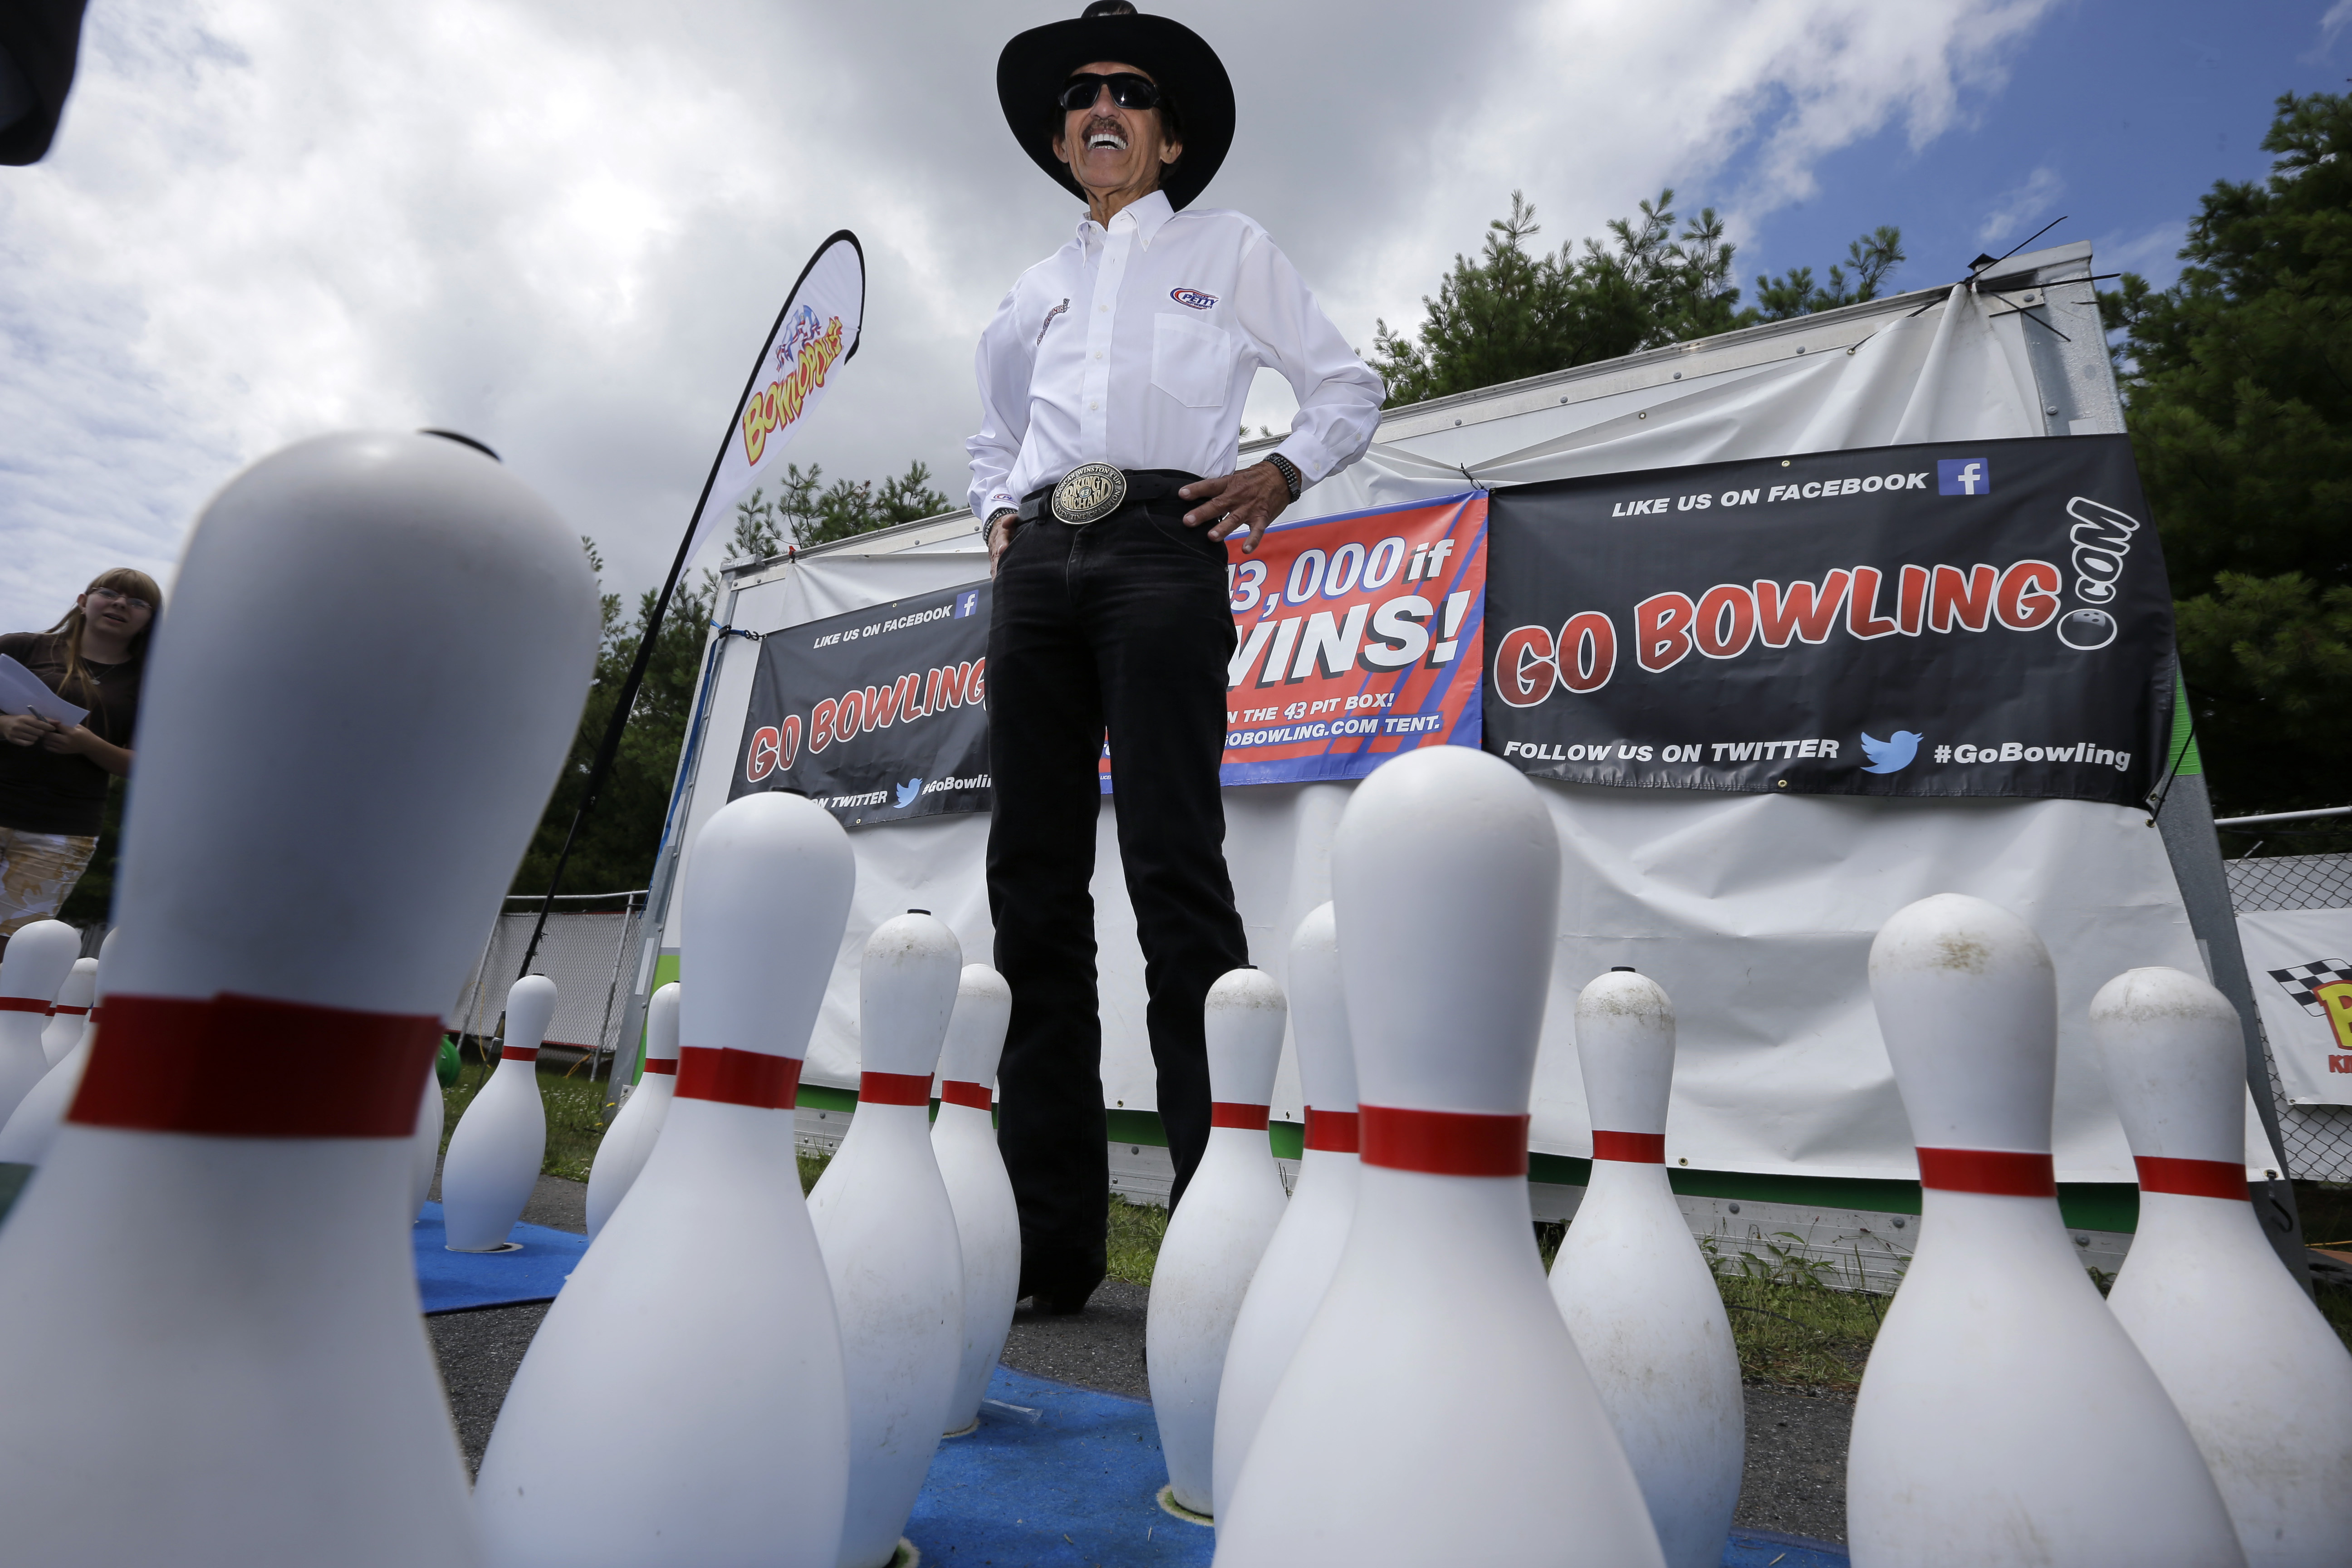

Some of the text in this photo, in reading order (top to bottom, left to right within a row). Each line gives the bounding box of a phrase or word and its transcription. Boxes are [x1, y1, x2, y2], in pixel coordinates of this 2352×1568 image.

[1182, 294, 1219, 306] PETTY
[743, 316, 843, 466] BOWLOPOLIS
[1056, 466, 1121, 497] NASCAR WINSTON CUP
[1072, 476, 1101, 497] KING
[1612, 472, 1930, 518] LIKE US ON FACEBOOK
[1055, 502, 1068, 518] SEVEN
[1089, 490, 1121, 517] CHAMPION
[1408, 539, 1455, 581] if
[813, 605, 953, 649] LIKE US ON FACEBOOK
[1494, 560, 2062, 708] GO BOWLING
[1244, 706, 1279, 722] THE
[1284, 701, 1307, 720] 43
[1310, 698, 1341, 715] PIT
[1344, 693, 1395, 710] BOX!
[1384, 715, 1440, 733] TENT.
[747, 714, 802, 783] GO
[1503, 739, 1840, 763] FOLLOW US ON TWITTER
[1934, 742, 2131, 772] #GoBowling
[831, 790, 888, 808] TWITTER
